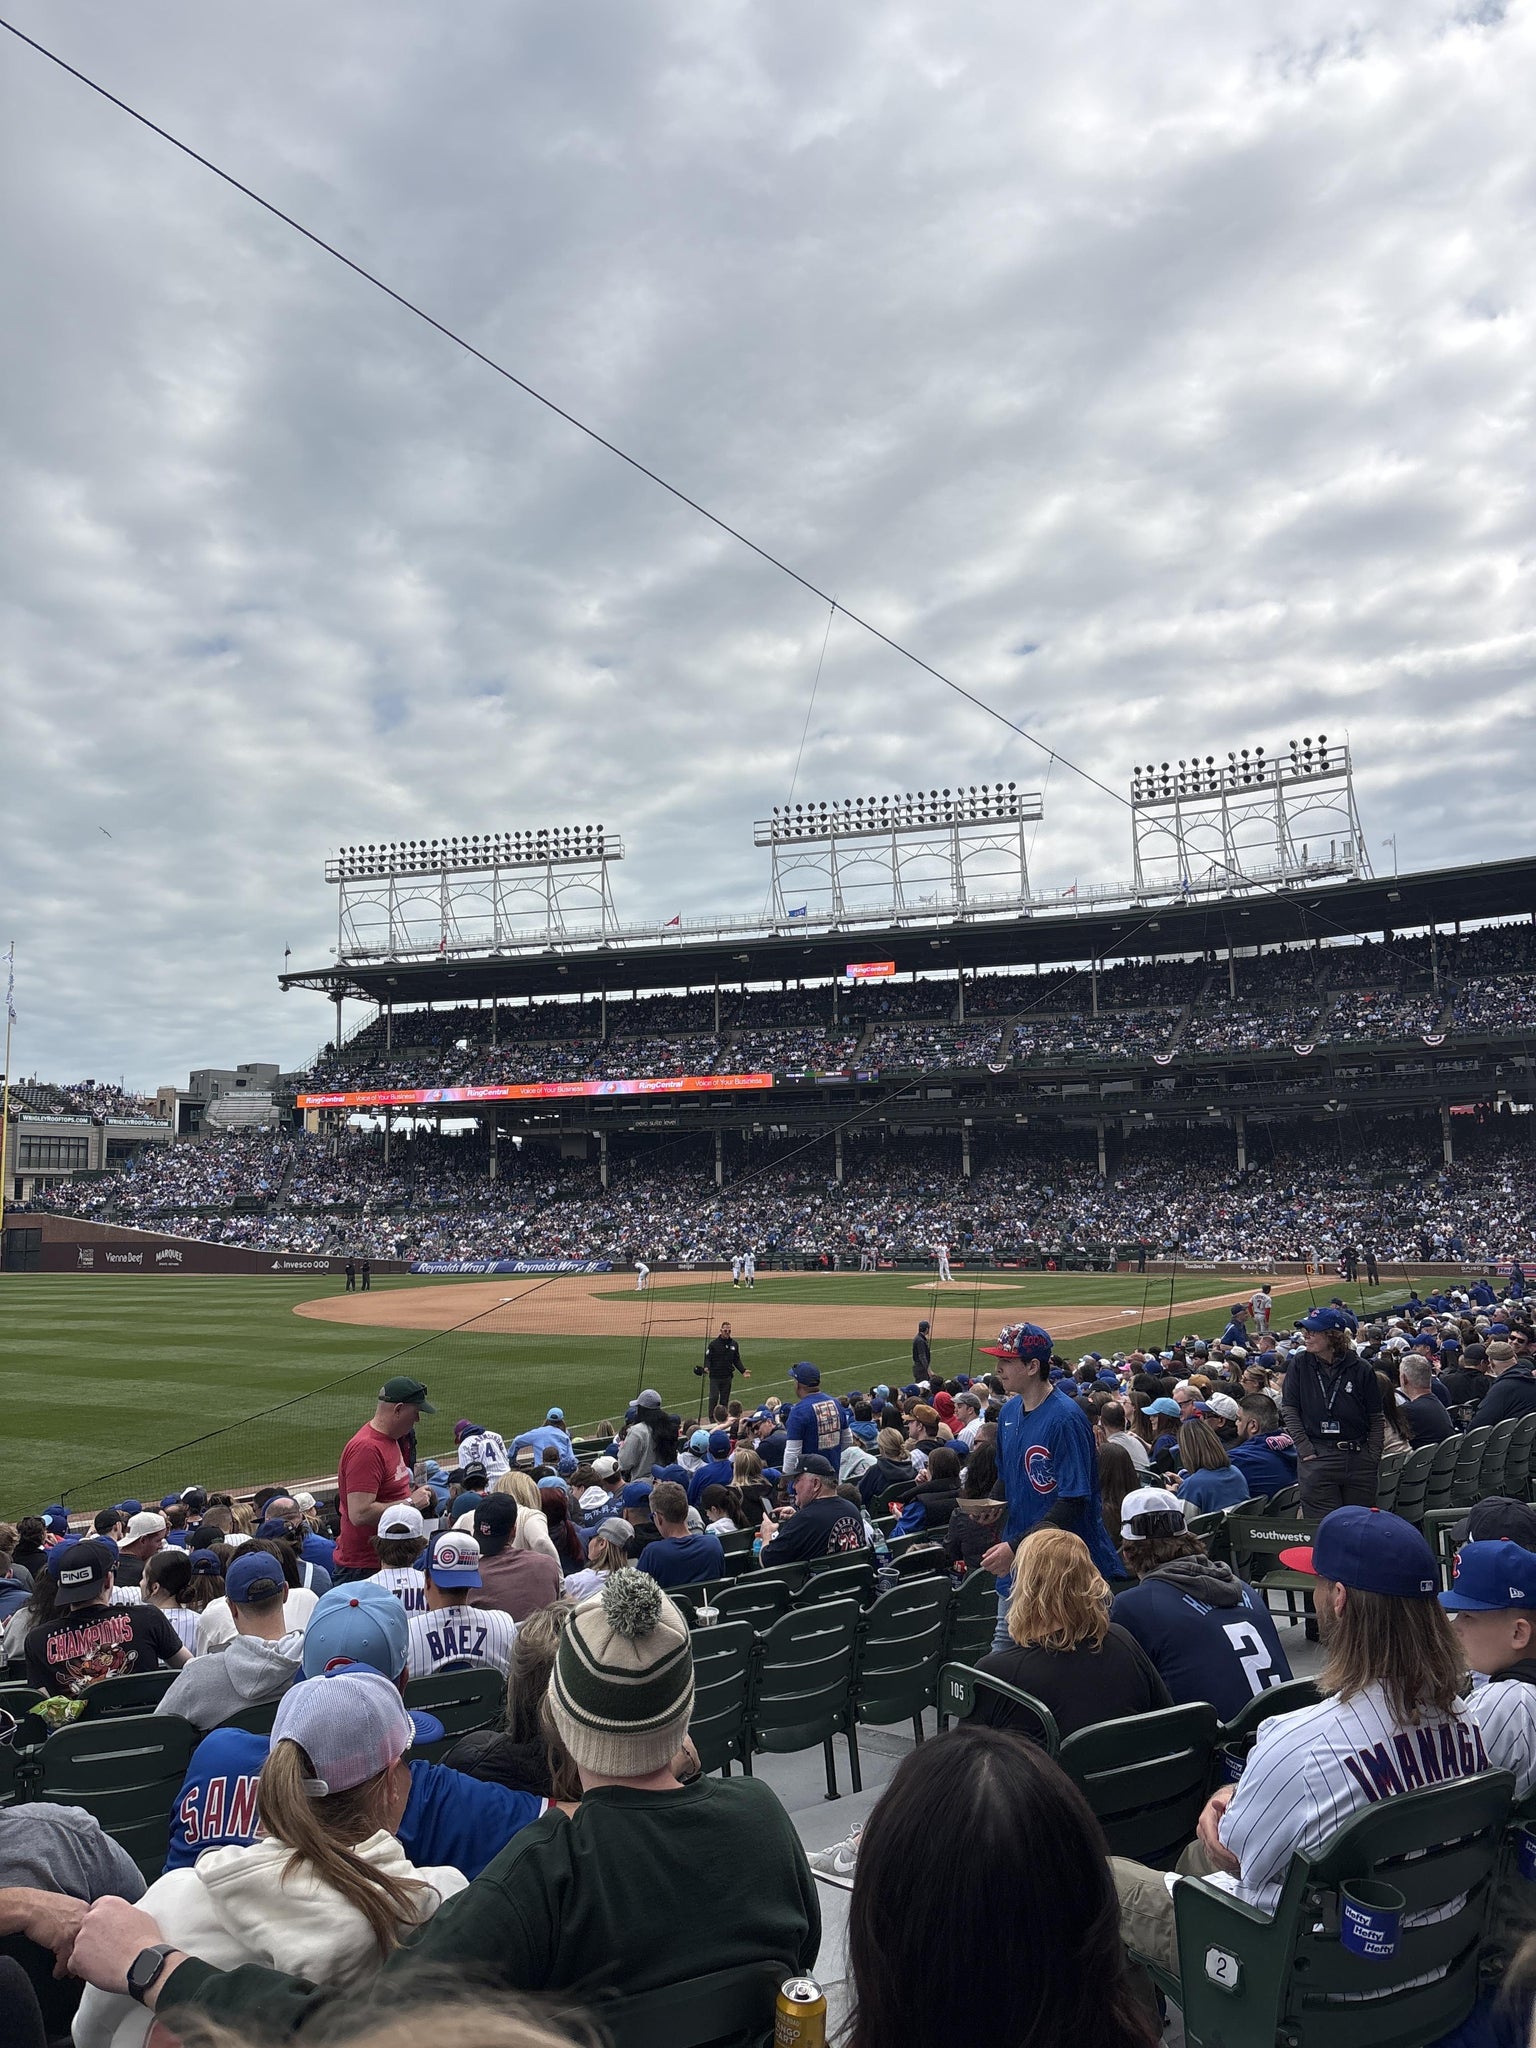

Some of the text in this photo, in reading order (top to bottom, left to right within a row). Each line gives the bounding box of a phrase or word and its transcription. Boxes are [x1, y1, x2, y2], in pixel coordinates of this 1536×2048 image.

[638, 1081, 683, 1089] RingCentral
[305, 1096, 345, 1104] RingCentral
[466, 1089, 509, 1097] RingCentral
[105, 1251, 128, 1263] Vienna
[127, 1251, 143, 1265] Beef
[155, 1248, 183, 1262] MARQUEE
[283, 1260, 330, 1269] Invesco QQQ
[418, 1262, 485, 1274] Reynolds Wrap
[513, 1261, 558, 1274] Reynolds
[485, 1441, 497, 1462] 4
[1249, 1529, 1304, 1543] Southwest
[62, 1569, 90, 1581] PING
[46, 1615, 134, 1665] CHAMPIONS
[426, 1619, 488, 1661] BÁEZ
[1222, 1621, 1282, 1697] 2
[950, 1680, 965, 1701] 105
[1343, 1721, 1493, 1804] IMANAGA
[1345, 1905, 1371, 1926] Hefty
[1354, 1927, 1382, 1941] Hefty
[1366, 1943, 1393, 1954] Hefty
[1216, 1956, 1226, 1979] 2
